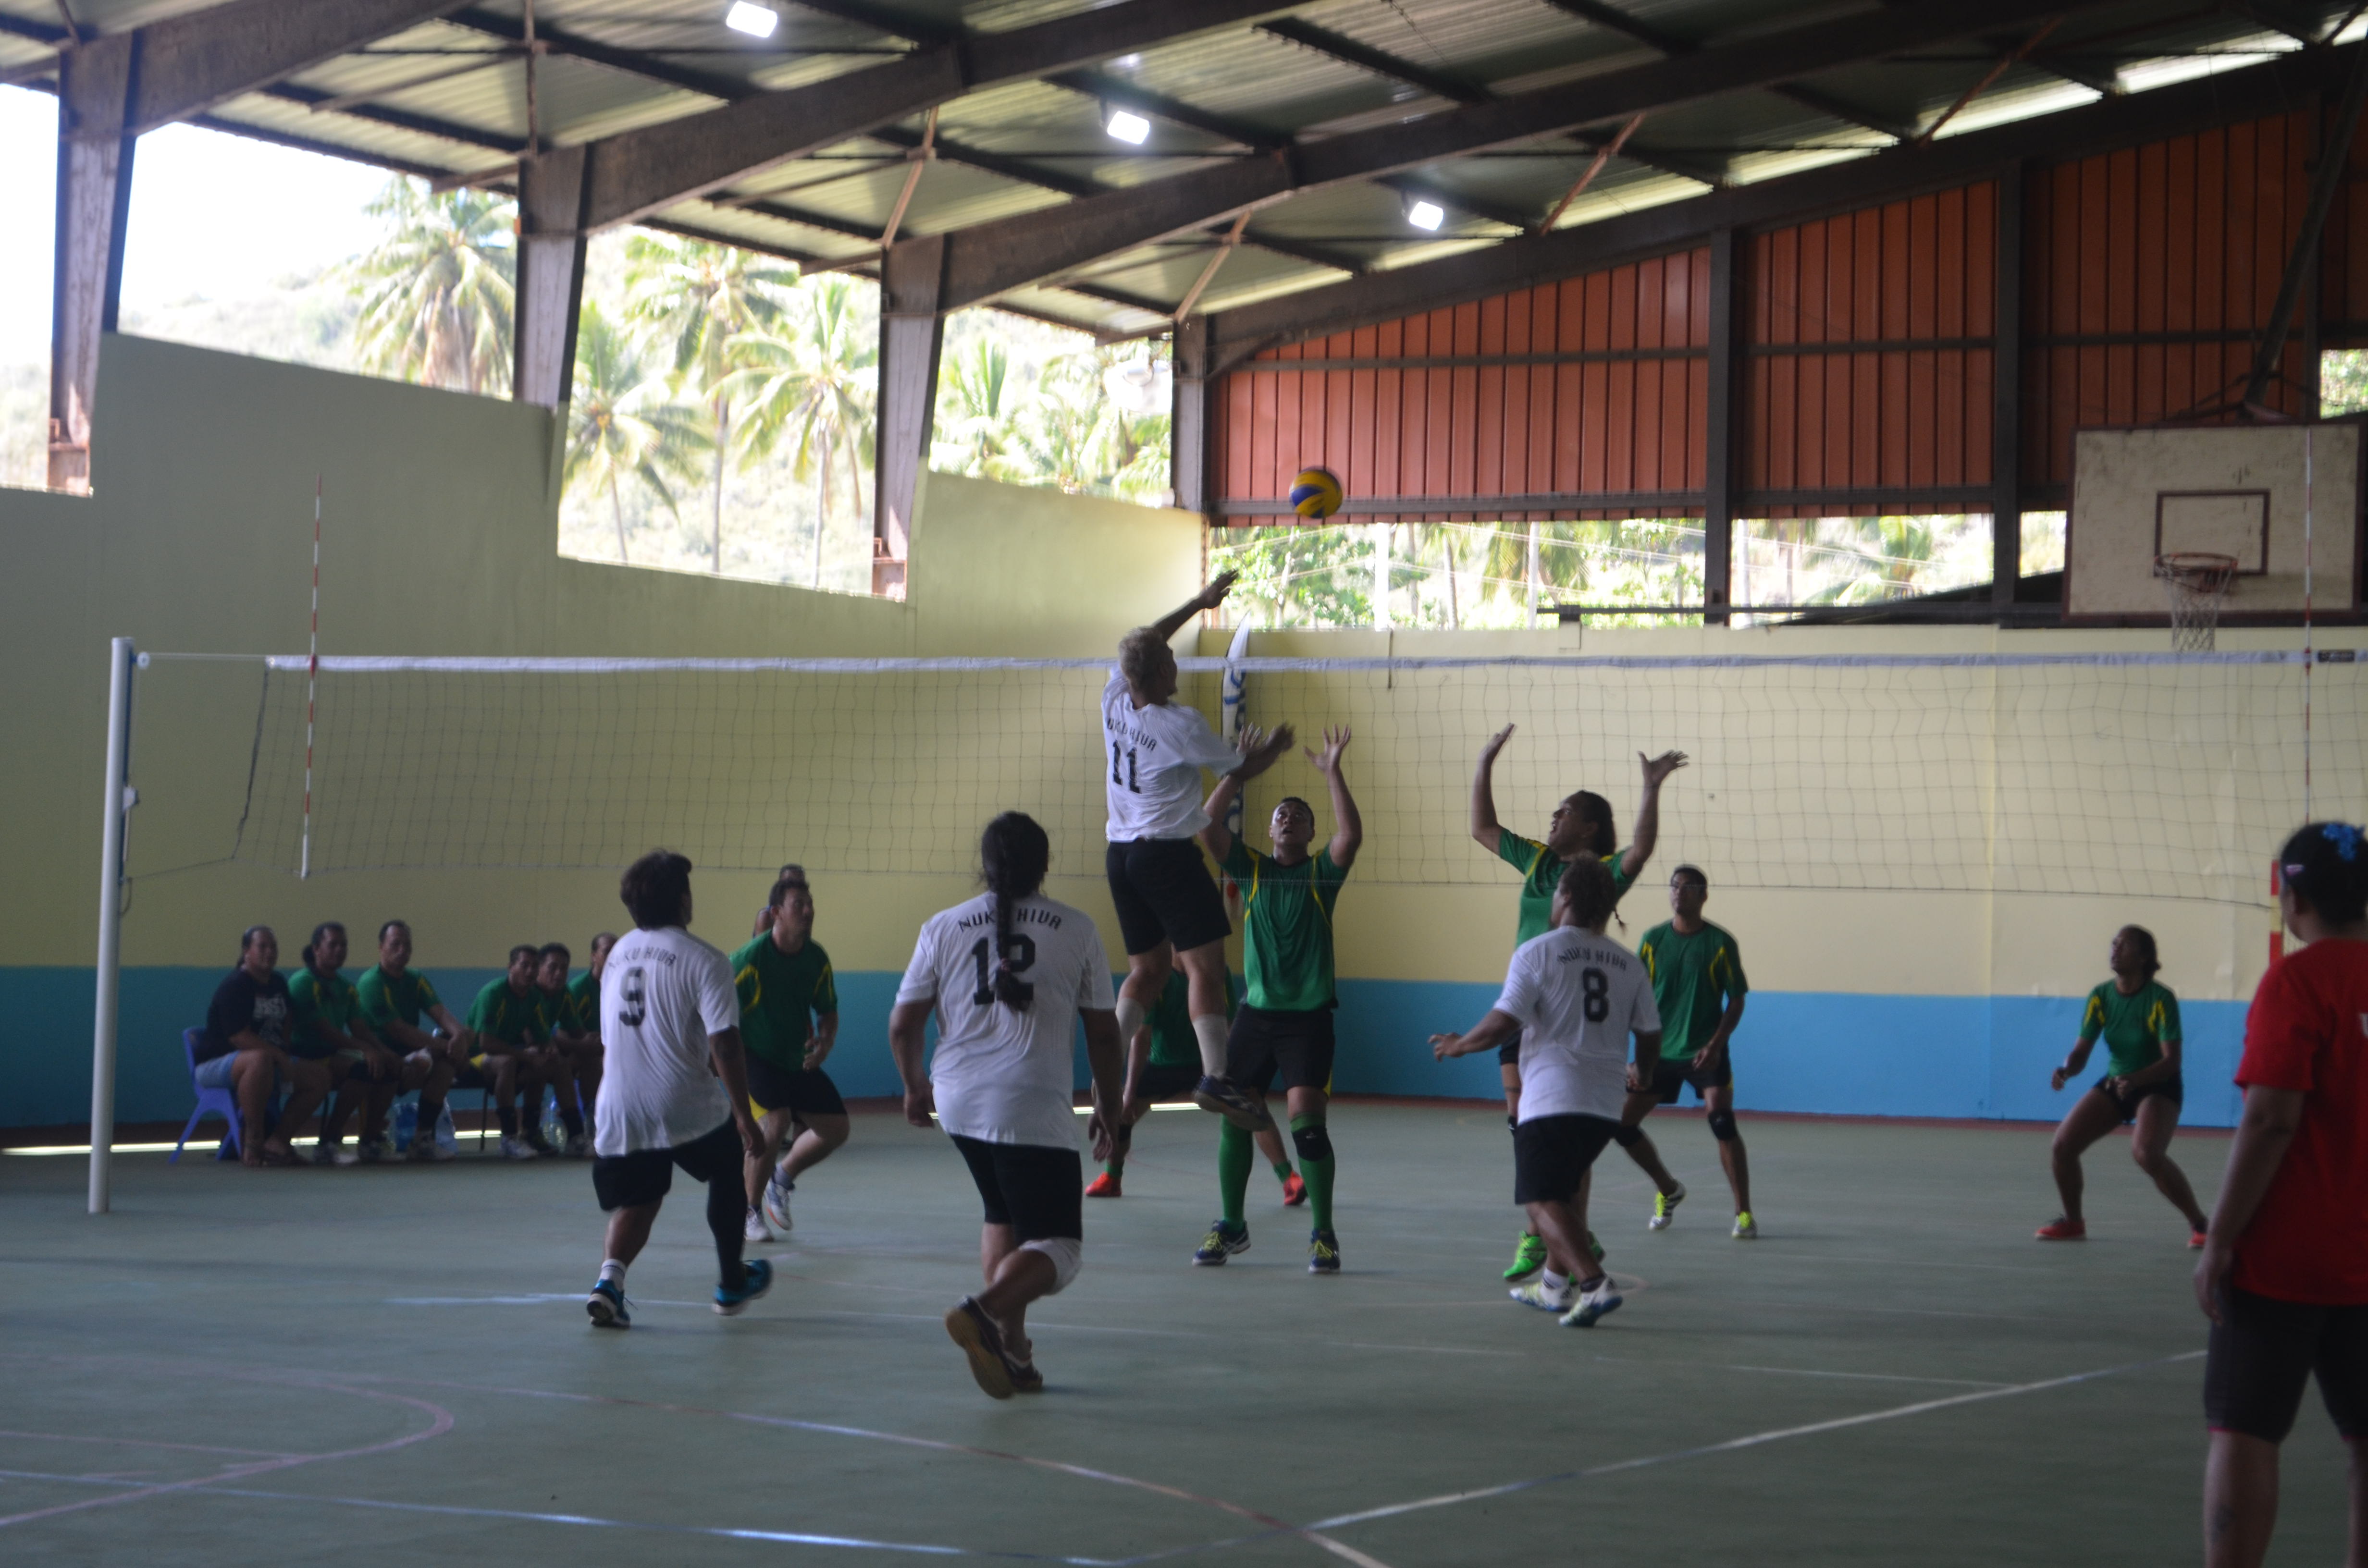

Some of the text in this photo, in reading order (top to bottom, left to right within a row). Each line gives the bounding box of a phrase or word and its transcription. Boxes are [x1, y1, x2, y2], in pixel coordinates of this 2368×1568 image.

[1112, 739, 1142, 794] 11
[958, 910, 996, 932] NUK
[618, 966, 647, 1026] 9
[971, 933, 1036, 1005] 12
[1582, 966, 1610, 1023] 8
